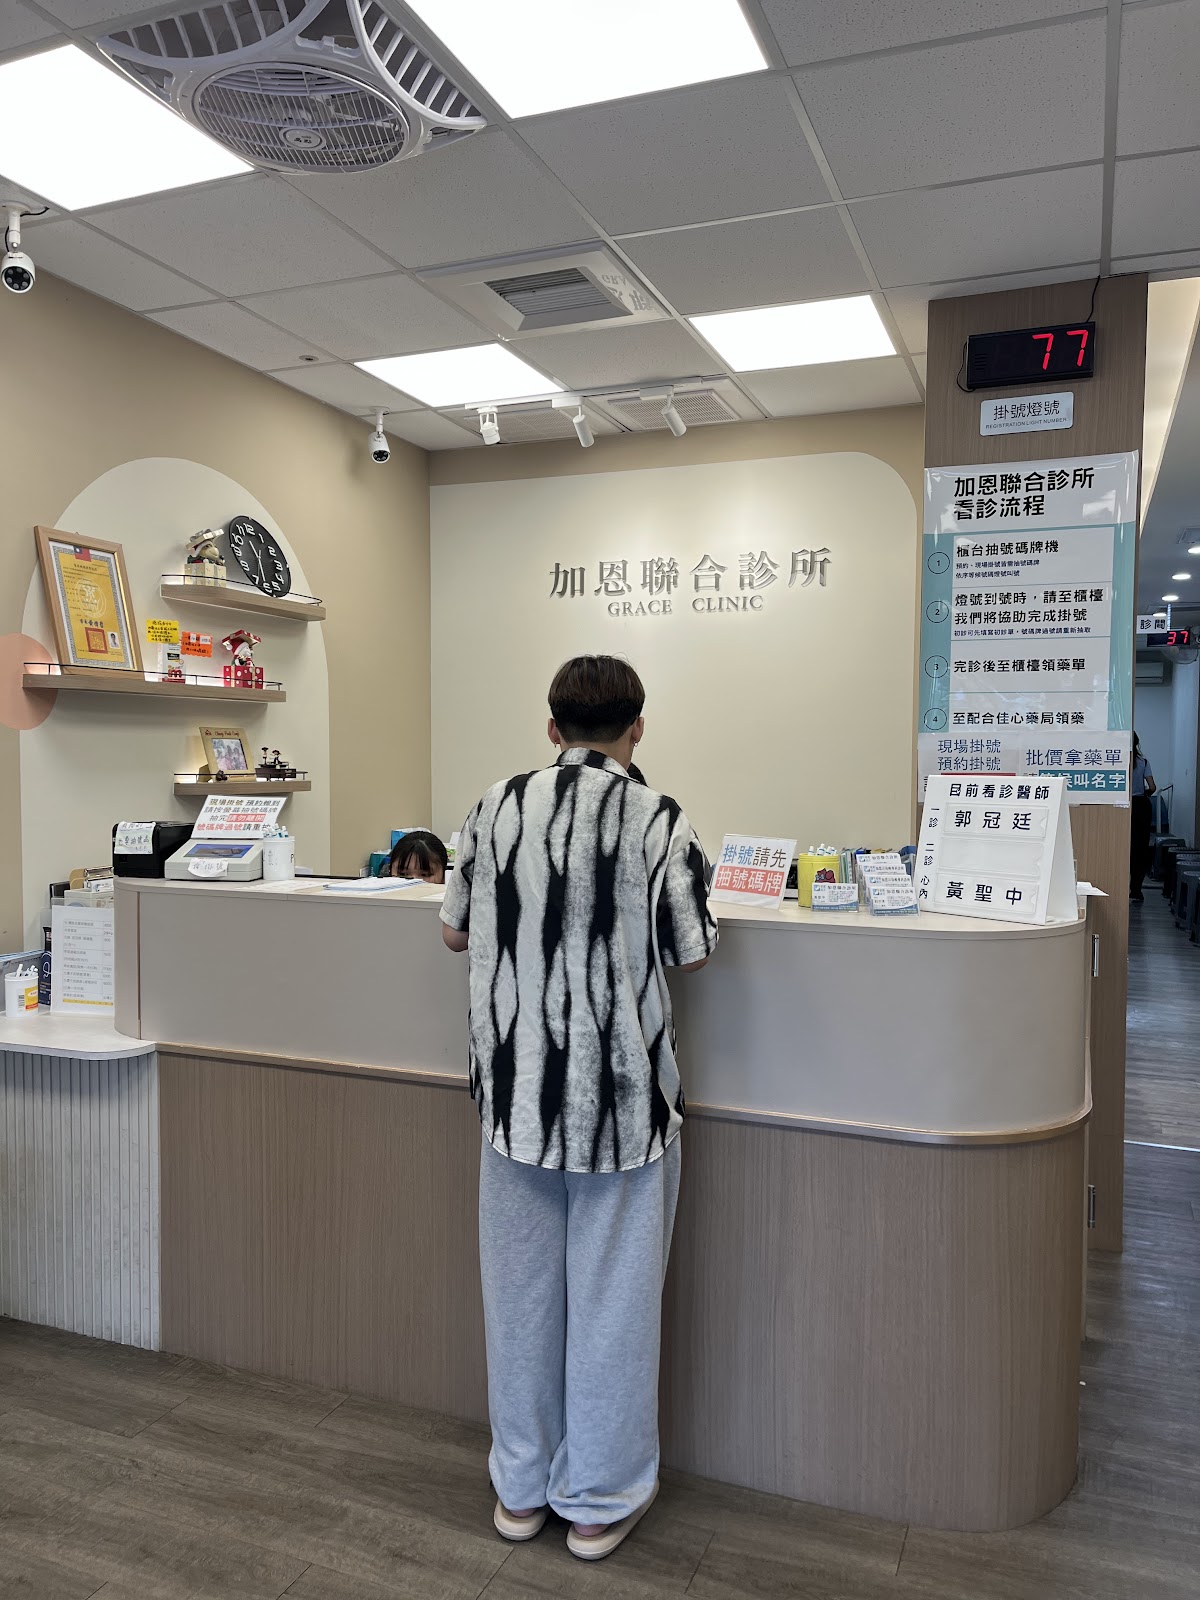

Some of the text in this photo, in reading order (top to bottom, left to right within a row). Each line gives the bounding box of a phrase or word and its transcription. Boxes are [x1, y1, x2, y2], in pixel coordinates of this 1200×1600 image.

[1032, 329, 1088, 370] 77
[993, 400, 1060, 421] 掛號燈號
[985, 421, 1026, 429] REGISTRATION
[953, 467, 1095, 497] 加恩聯合診所
[953, 495, 1045, 520] 看診流程
[236, 524, 246, 536] 11
[243, 522, 256, 536] 12
[231, 532, 244, 546] 10
[258, 533, 265, 544] 1
[233, 546, 242, 557] 9
[267, 545, 277, 557] 2
[956, 540, 1059, 558] 櫃台抽號碼牌機
[240, 560, 250, 571] 8
[273, 559, 283, 571] 3
[252, 574, 259, 585] 7
[274, 573, 285, 585] 4
[549, 547, 833, 599] 加恩聯合診所
[263, 582, 273, 593] 6
[271, 581, 281, 591] 5
[607, 595, 764, 617] GRACE CLINIC
[954, 608, 1088, 625] 我們將協助完成掛號
[1140, 619, 1166, 630] 診間
[1167, 631, 1189, 645] 37
[953, 658, 1086, 673] 完診後至櫃檯領藥單
[952, 711, 1085, 725] 至配合佳心藥局領藥
[937, 739, 1001, 754] 現場掛號
[937, 756, 1001, 771] 預約掛號
[1025, 749, 1123, 766] 批價拿藥單
[949, 783, 1050, 800] 目前看診醫師
[954, 810, 1032, 830] 郭冠廷
[722, 843, 787, 869] 掛號請先
[716, 868, 784, 894] 抽號碼牌
[945, 881, 1023, 905] 黃聖中
